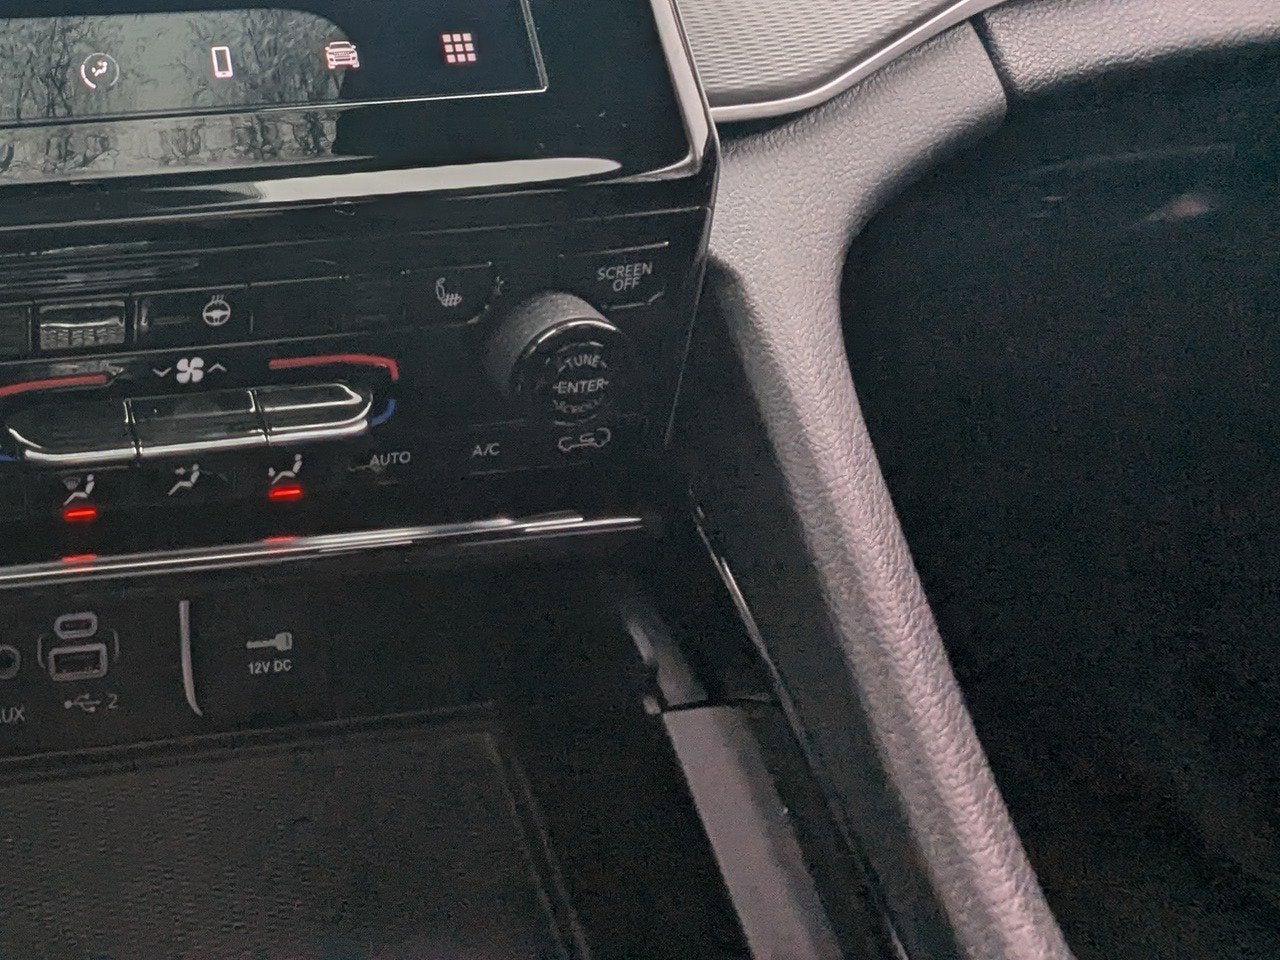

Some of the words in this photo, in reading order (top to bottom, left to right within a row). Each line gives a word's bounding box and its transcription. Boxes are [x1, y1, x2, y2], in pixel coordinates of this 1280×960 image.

[596, 262, 654, 281] SCREEN
[612, 276, 641, 292] OFF
[565, 354, 601, 368] TUNE
[472, 442, 500, 458] A/C
[369, 451, 412, 466] AUTO
[248, 660, 271, 674] 12V
[273, 659, 293, 673] DC
[107, 694, 119, 710] 2
